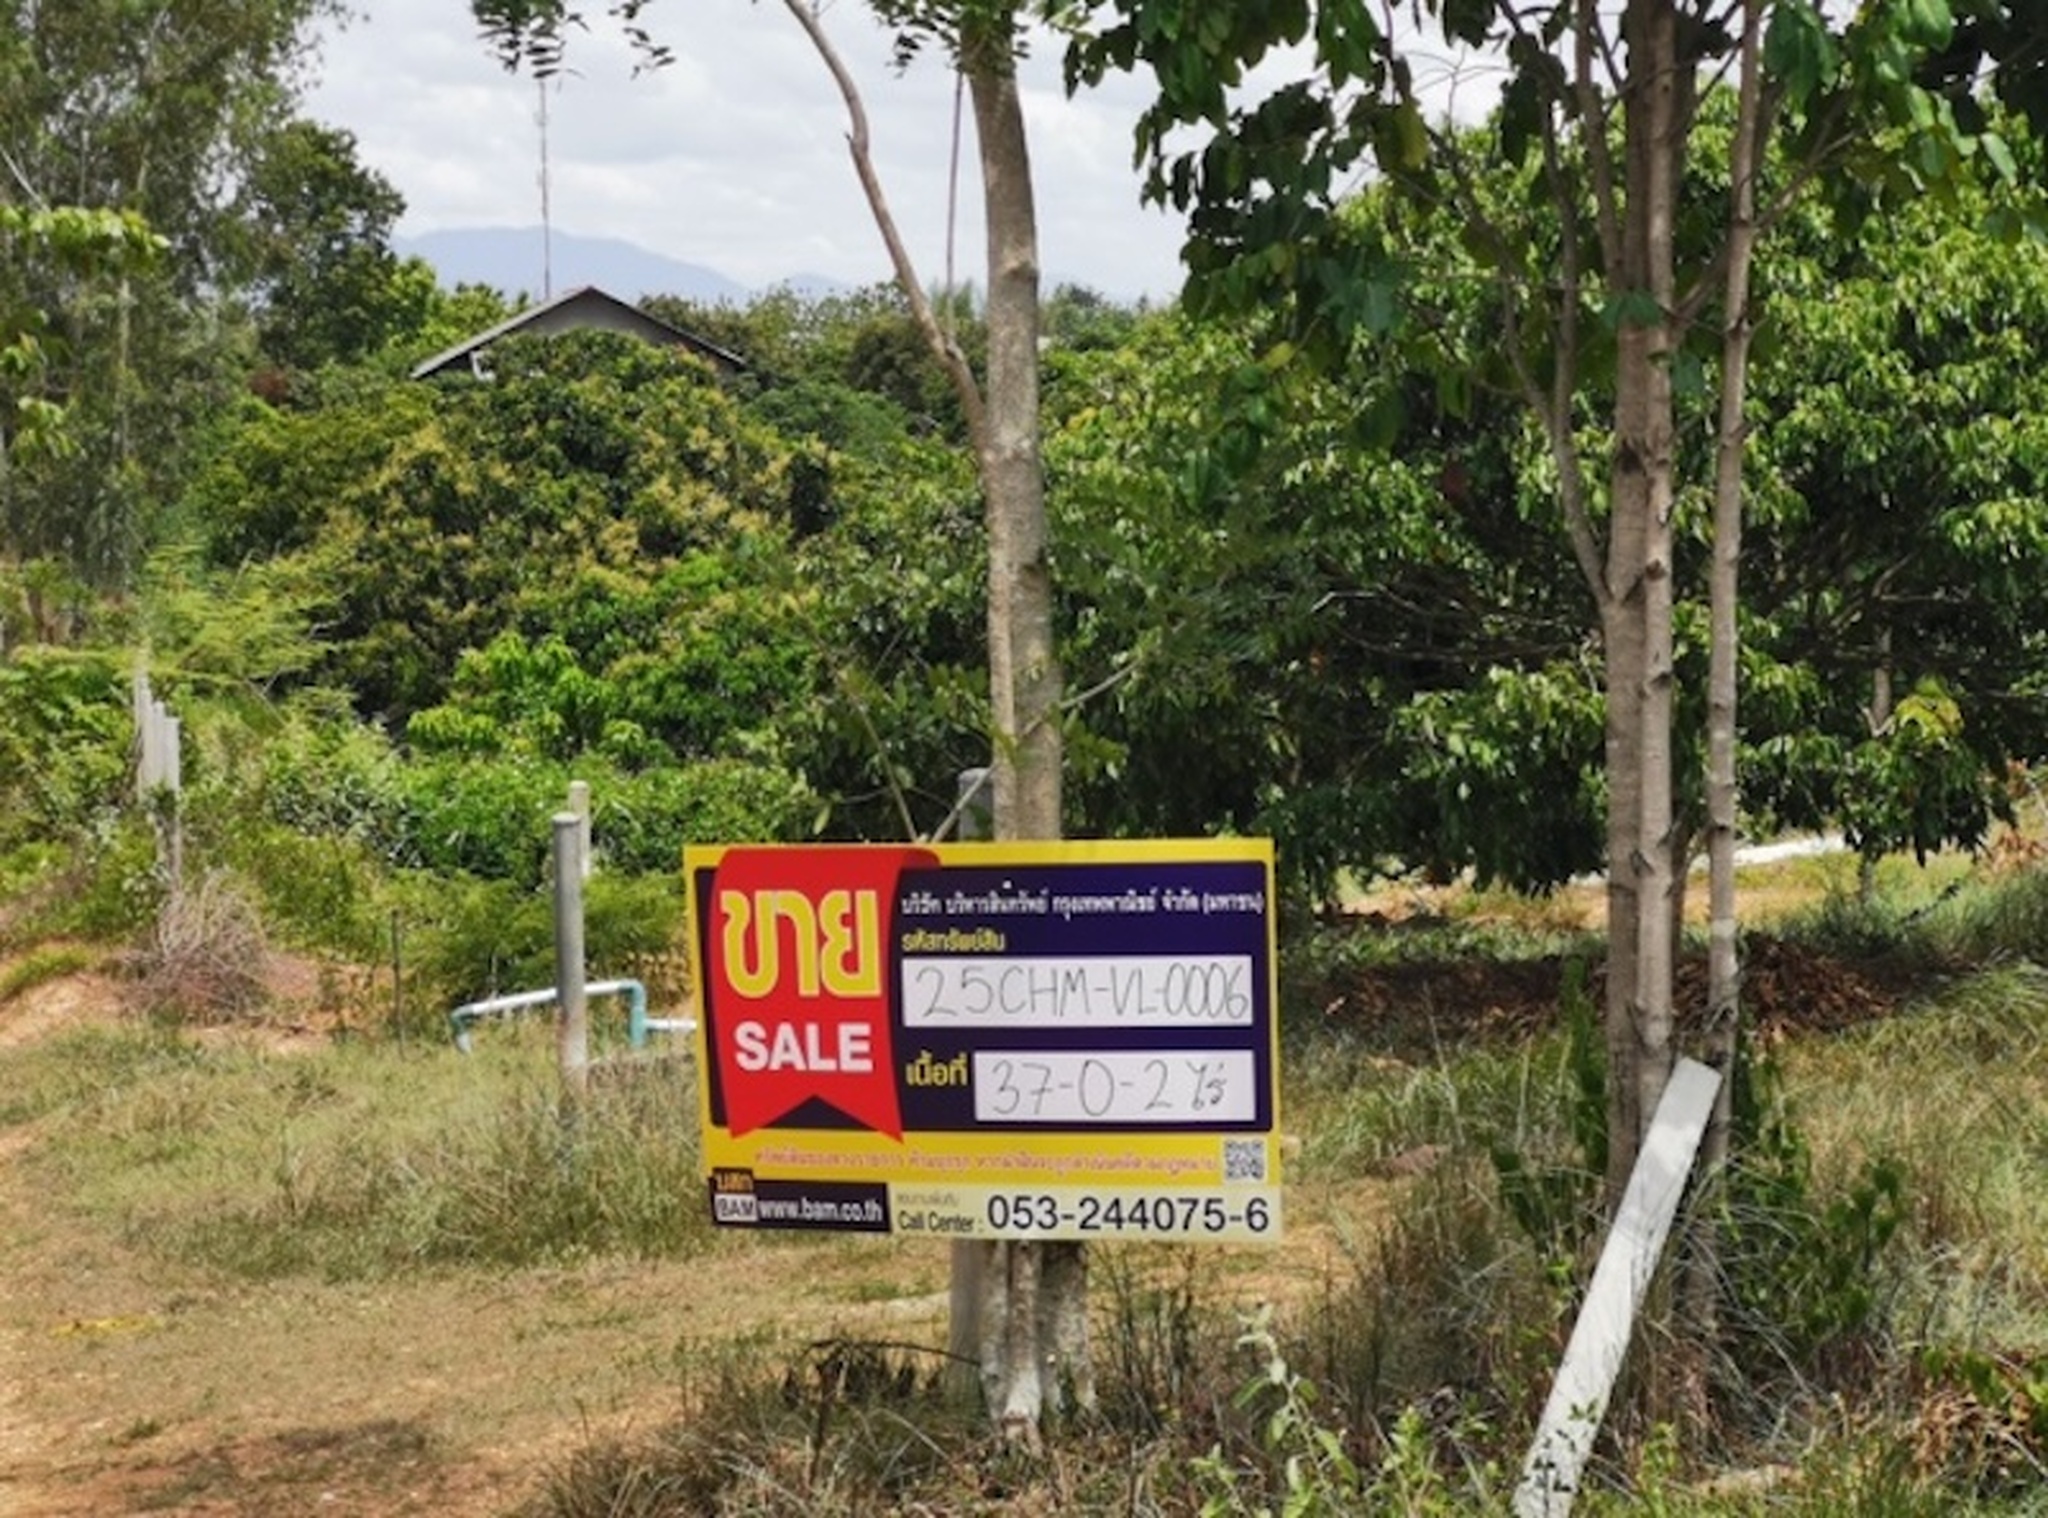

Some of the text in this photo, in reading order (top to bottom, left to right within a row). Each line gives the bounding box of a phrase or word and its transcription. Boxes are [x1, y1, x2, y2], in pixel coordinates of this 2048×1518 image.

[720, 889, 882, 998] ขาย
[915, 962, 1249, 1019] 25CHM-VL-0006
[734, 1020, 873, 1073] SALE
[905, 1050, 968, 1087] เนื้อที่
[759, 1197, 883, 1222] www.bam.co.th
[898, 1209, 925, 1231] Call
[987, 1195, 1269, 1232] 053-244075-6
